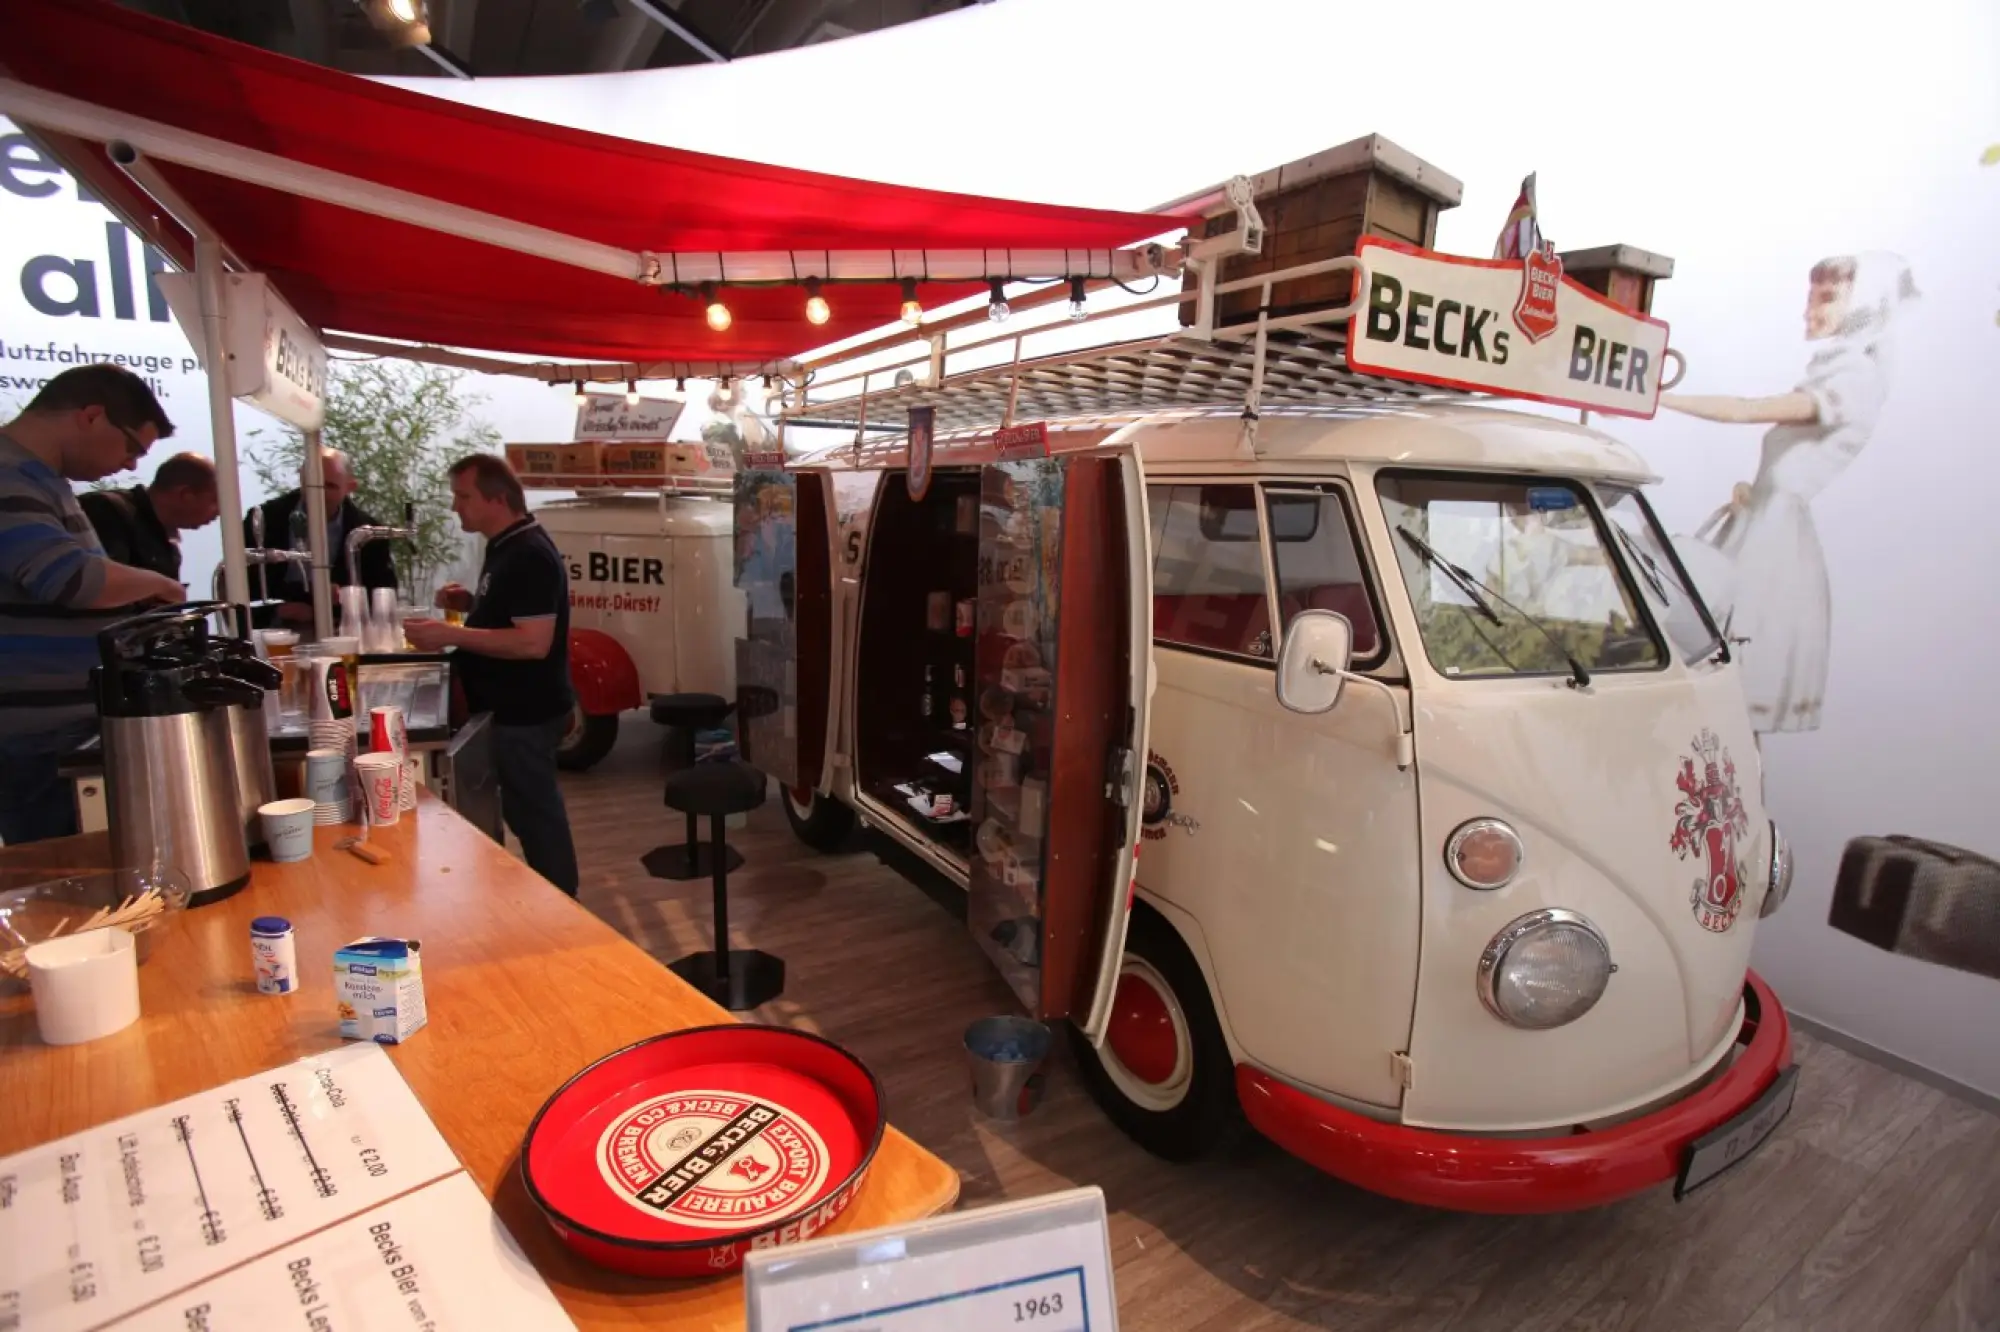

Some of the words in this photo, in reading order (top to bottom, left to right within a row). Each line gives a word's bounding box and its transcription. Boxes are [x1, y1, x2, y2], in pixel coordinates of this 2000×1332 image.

[1532, 283, 1554, 302] BIER
[1366, 272, 1510, 366] BECK's
[1567, 325, 1650, 395] BIER
[588, 551, 665, 585] BIER
[315, 1067, 346, 1109] Coca-Cola
[617, 1126, 654, 1185] BREMEN
[701, 1107, 775, 1156] BECK's
[770, 1123, 810, 1179] EXPORT
[642, 1157, 713, 1205] BIER
[681, 1178, 801, 1214] BRAUEREI
[287, 1256, 319, 1307] Becks
[368, 1221, 401, 1266] Becks
[391, 1264, 420, 1296] Bier
[1012, 1292, 1064, 1323] 1963
